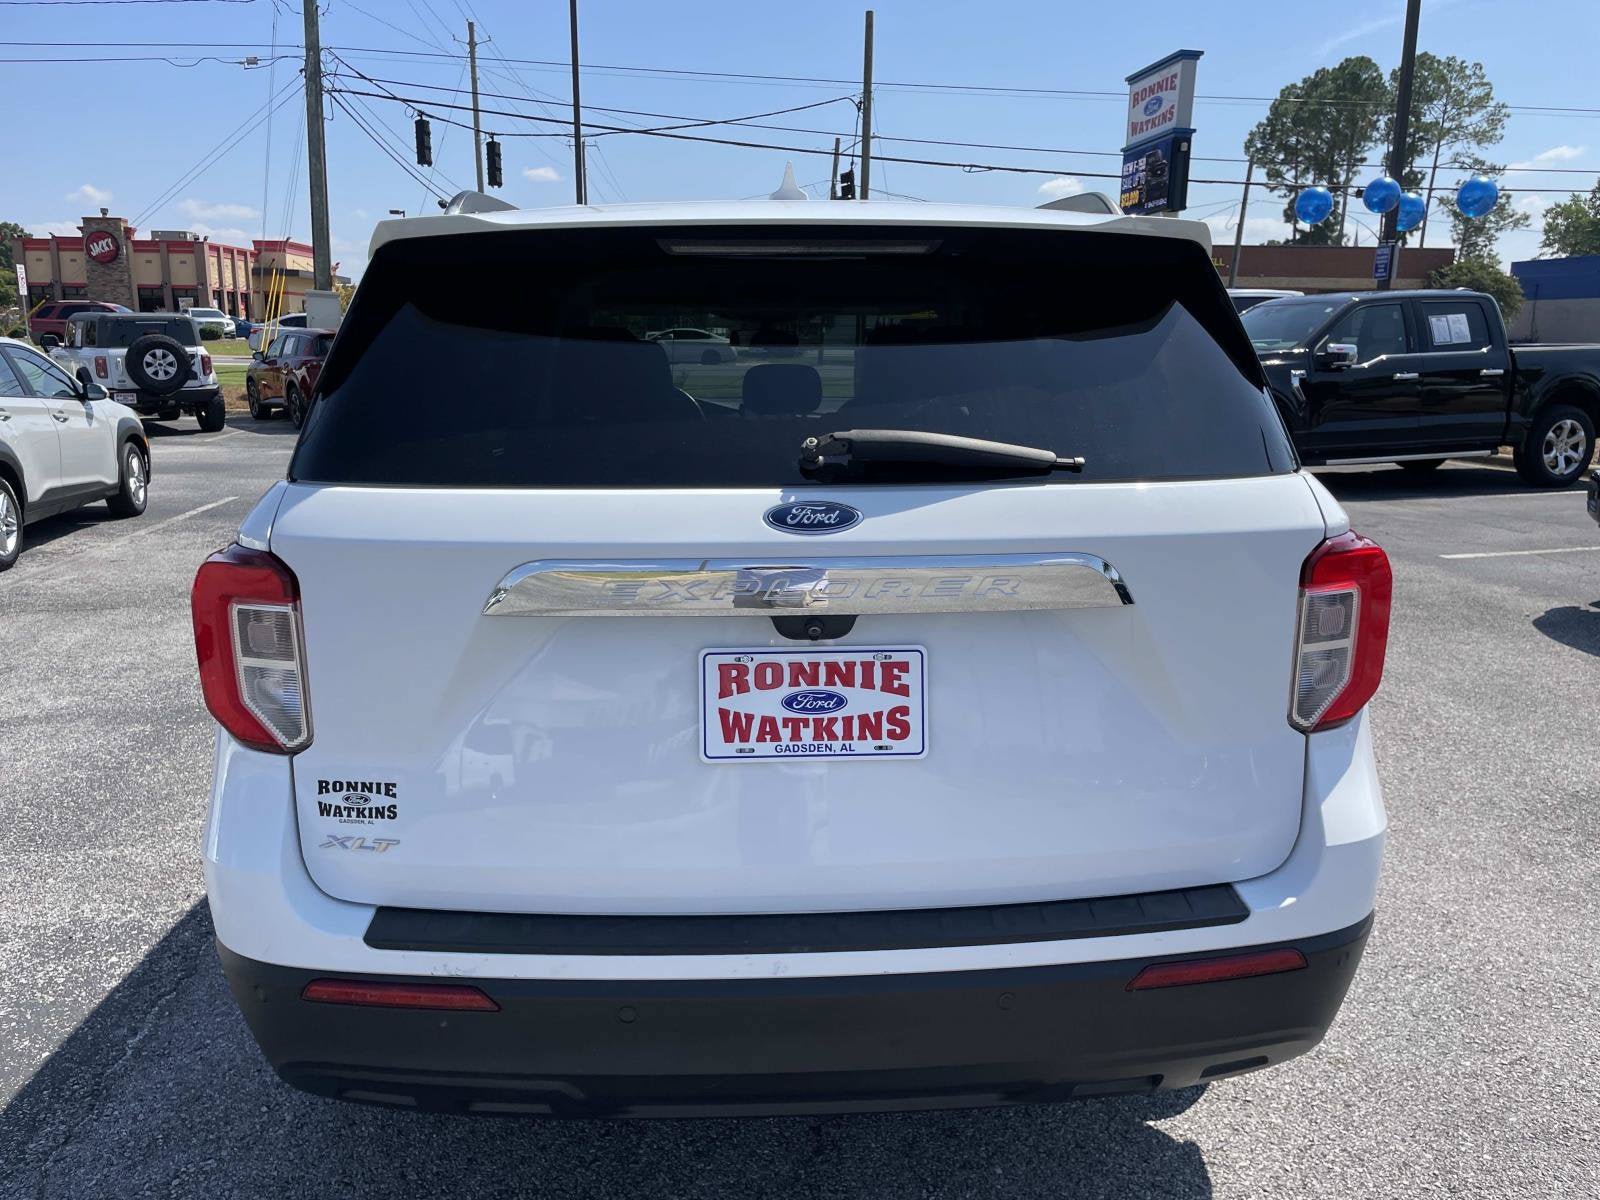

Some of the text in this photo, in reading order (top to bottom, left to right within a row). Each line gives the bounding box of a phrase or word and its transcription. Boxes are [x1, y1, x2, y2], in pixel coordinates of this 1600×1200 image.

[1132, 72, 1178, 109] RONNIE
[1131, 104, 1175, 137] WATKINS
[787, 505, 840, 525] Ford
[601, 574, 1023, 601] EXPLORER
[718, 660, 910, 699] RONNIE
[793, 692, 838, 709] Ford
[718, 705, 911, 744] WATKINS
[774, 744, 856, 754] GADSDEN, AL
[317, 779, 397, 799] RONNIE
[317, 801, 398, 820] WATKINS
[318, 835, 401, 853] XLT
